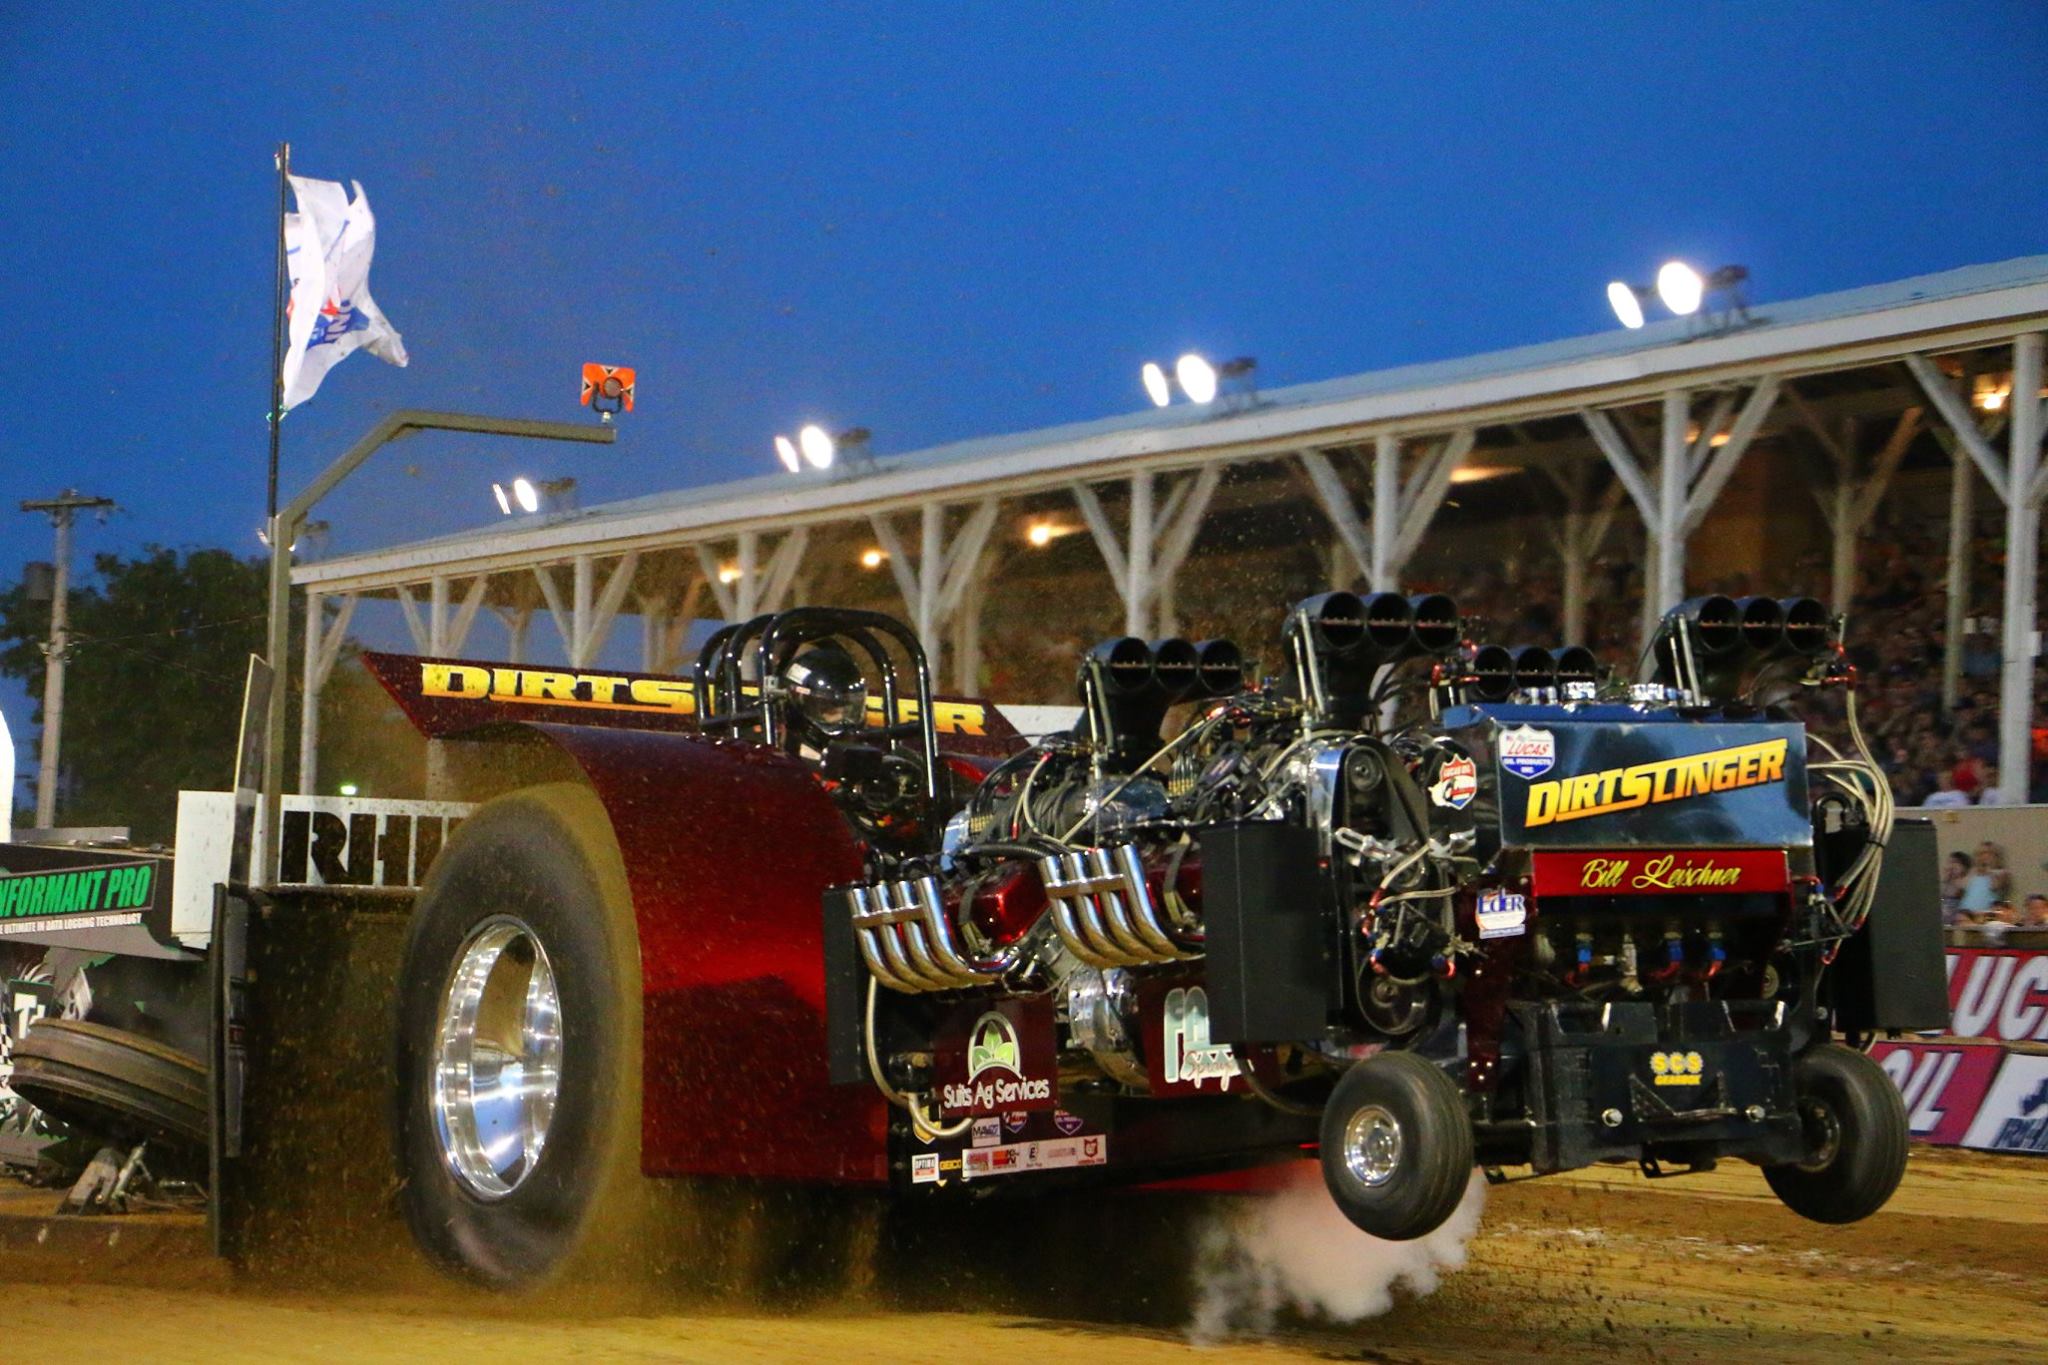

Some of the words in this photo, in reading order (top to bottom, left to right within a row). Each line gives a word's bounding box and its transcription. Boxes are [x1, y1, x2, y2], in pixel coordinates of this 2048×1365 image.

[1504, 743, 1549, 756] LUCAS
[1524, 738, 1788, 828] DIRTSLINGER
[103, 865, 152, 909] PRO
[1580, 858, 1629, 888] Bill
[1631, 854, 1742, 889] Leischner
[1651, 1052, 1703, 1073] SCS
[943, 1083, 973, 1109] Suits
[973, 1081, 995, 1110] Ag
[995, 1076, 1050, 1104] Services
